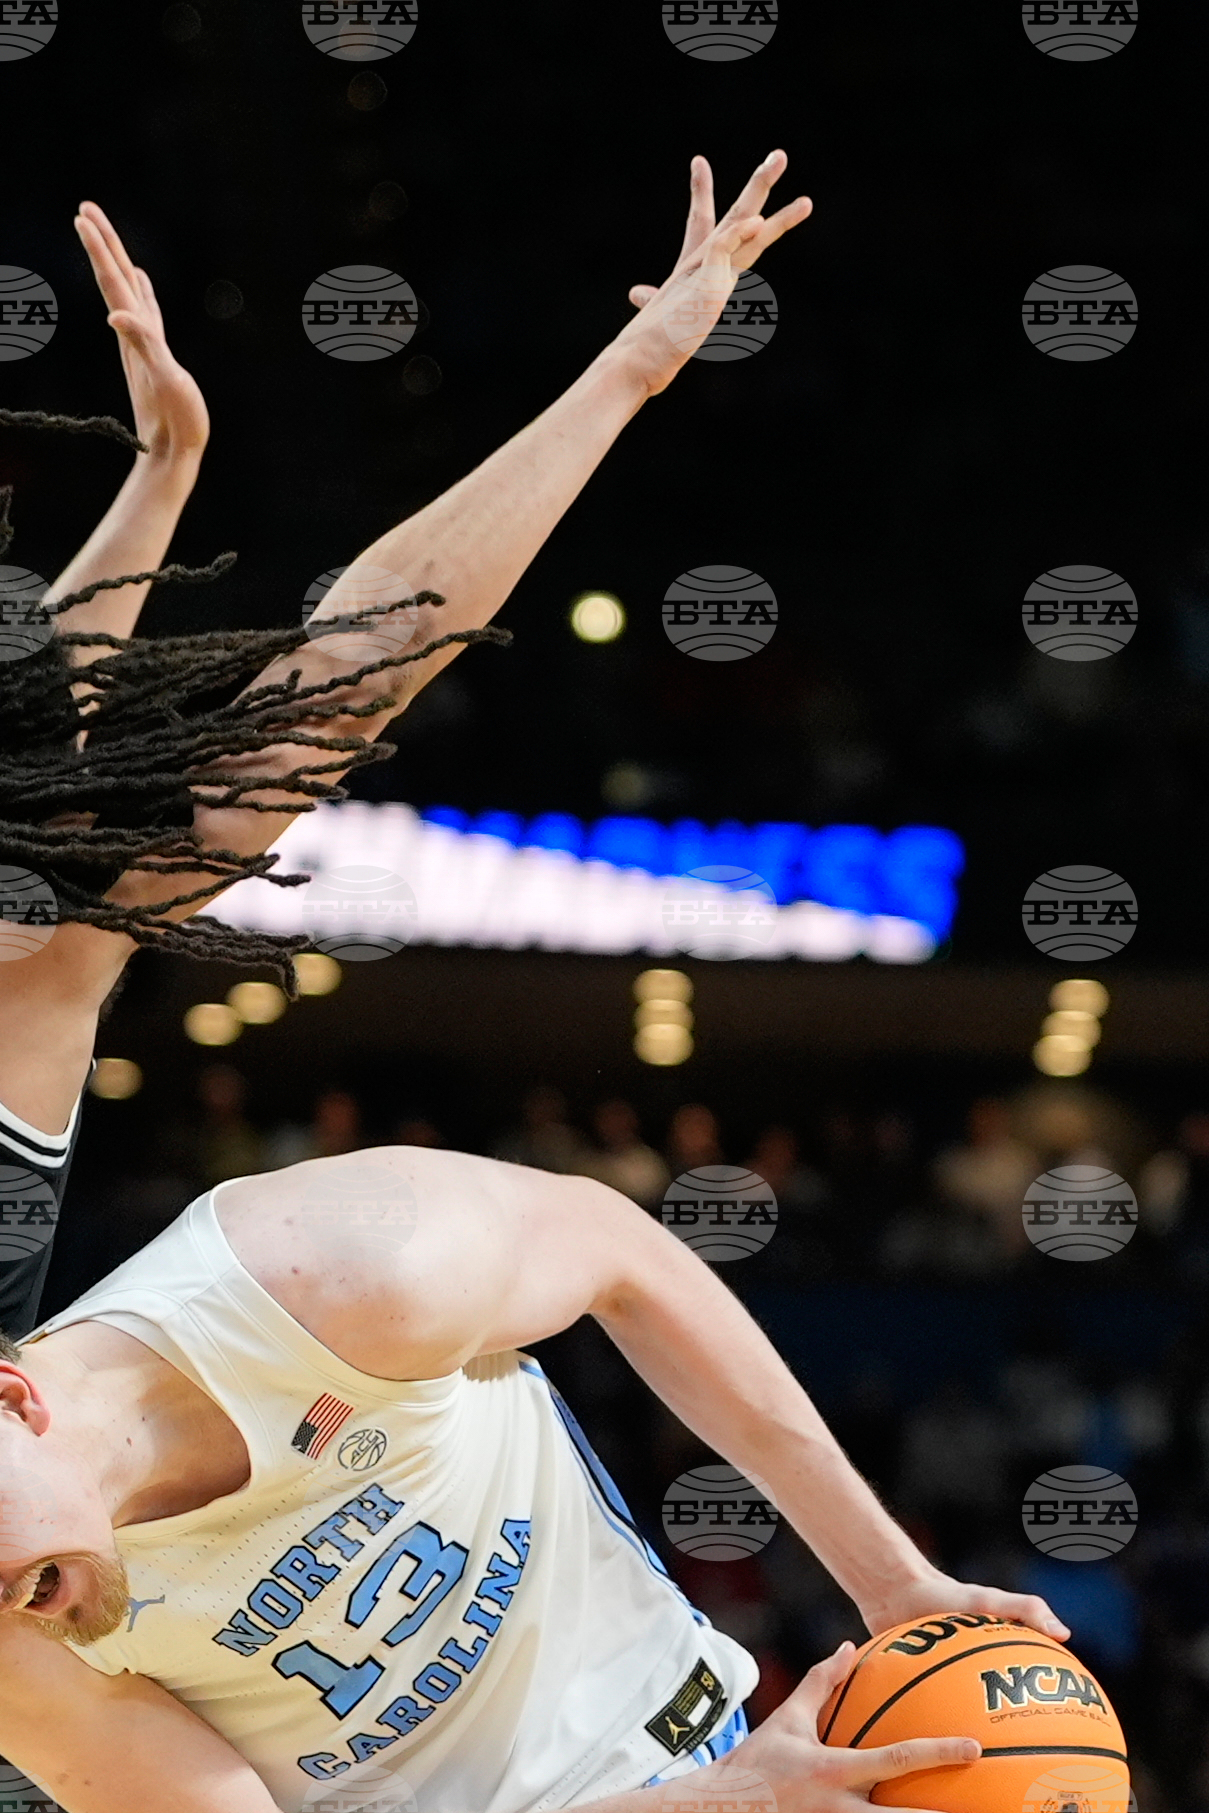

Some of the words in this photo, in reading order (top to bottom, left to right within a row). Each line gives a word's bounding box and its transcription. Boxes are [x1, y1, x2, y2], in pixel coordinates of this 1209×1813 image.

[212, 1482, 405, 1657] NORTH
[271, 1520, 470, 1721] 13
[297, 1517, 532, 1781] CAROLINA
[979, 1664, 1108, 1712] NCAA
[990, 1708, 1052, 1724] OFFICIAL
